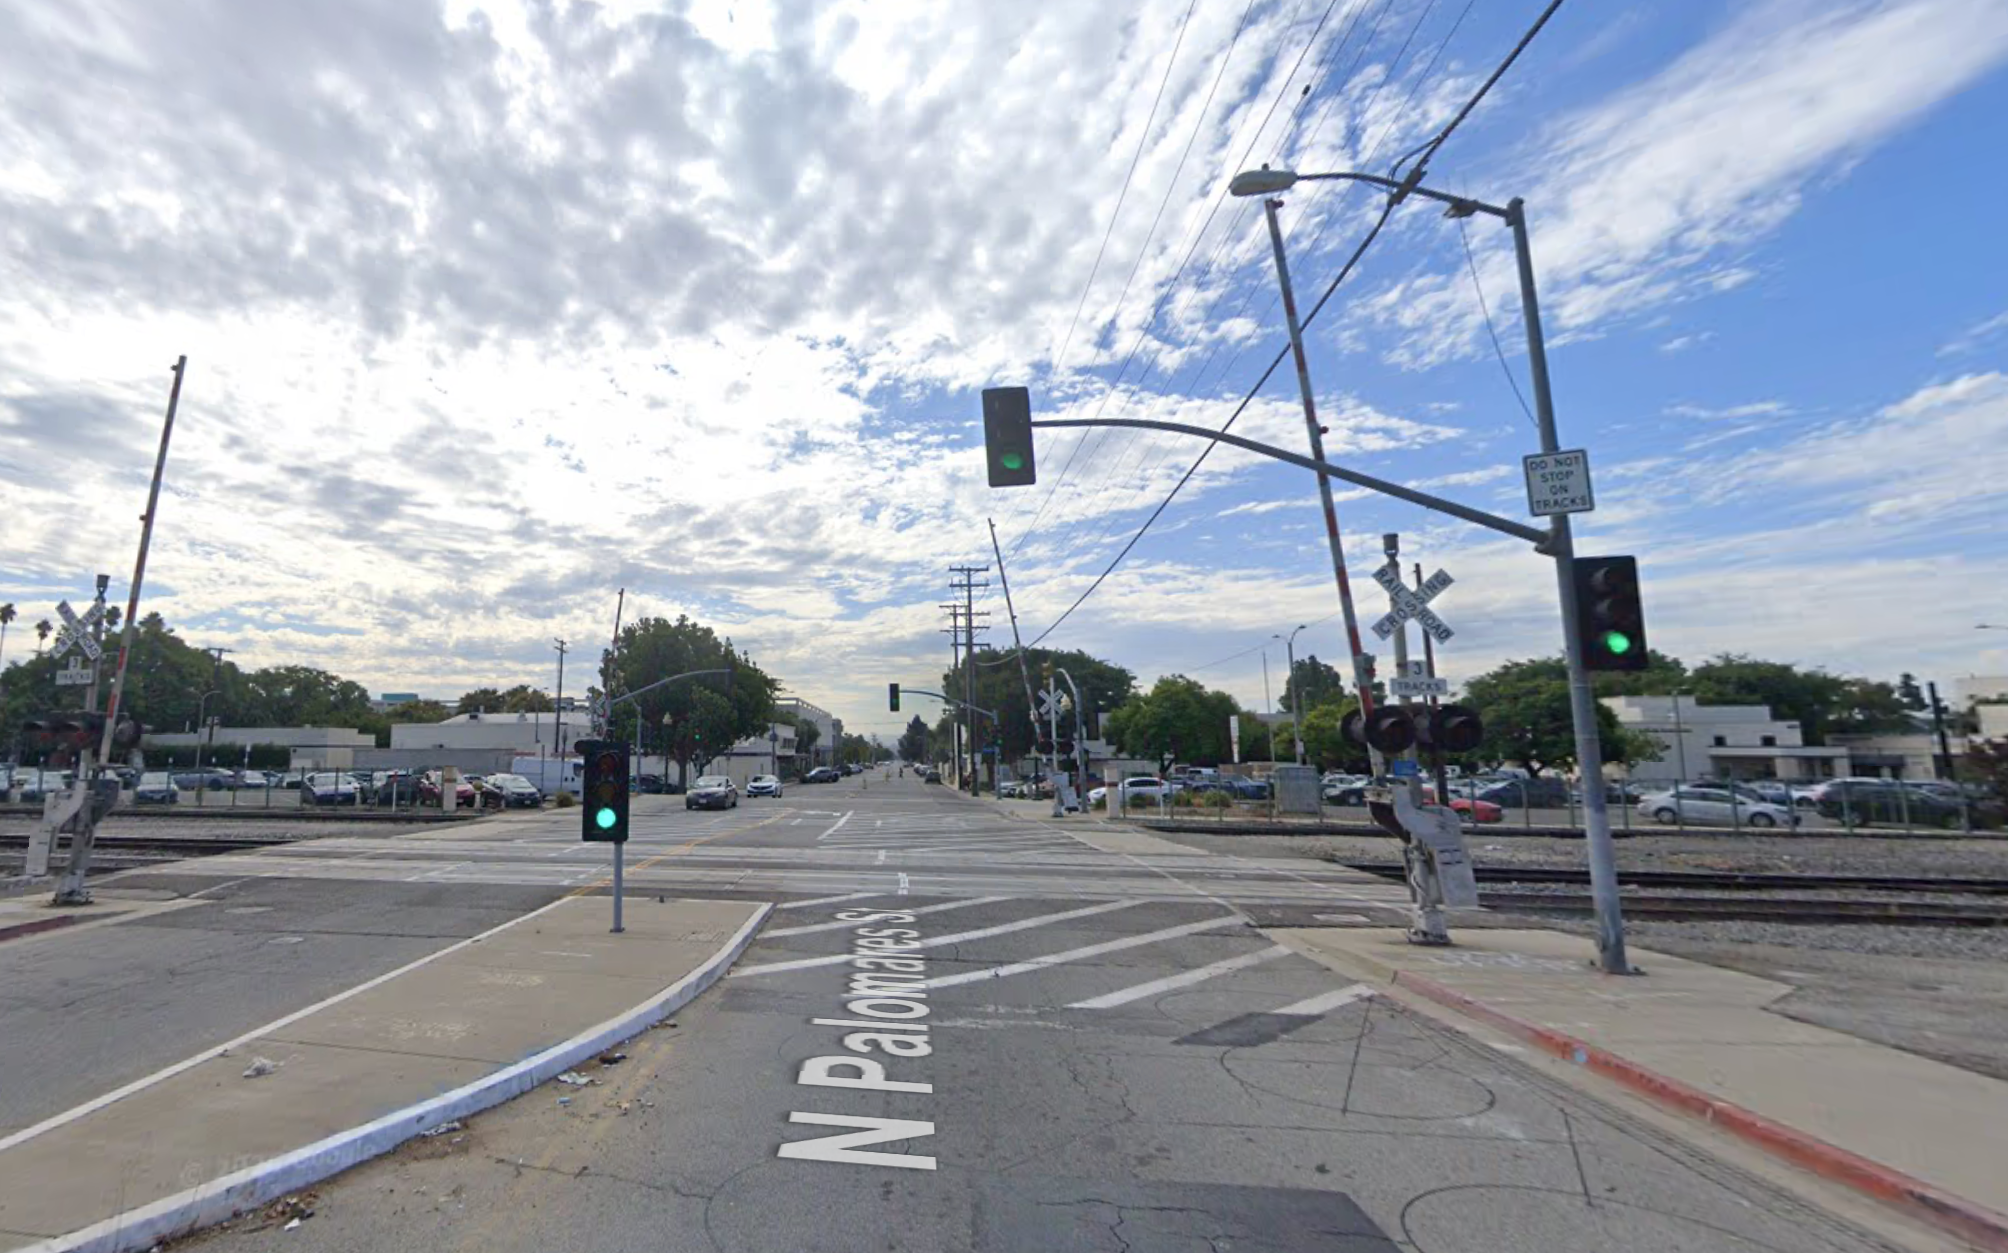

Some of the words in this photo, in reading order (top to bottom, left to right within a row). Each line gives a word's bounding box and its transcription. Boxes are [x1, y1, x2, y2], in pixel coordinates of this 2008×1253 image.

[1529, 460, 1548, 471] DO
[1554, 456, 1580, 467] NOT
[1540, 470, 1574, 483] STOP
[1549, 484, 1568, 495] ON
[1535, 495, 1588, 510] TRACKS
[1378, 574, 1449, 636] CROSSING
[1398, 681, 1442, 693] TRACKS
